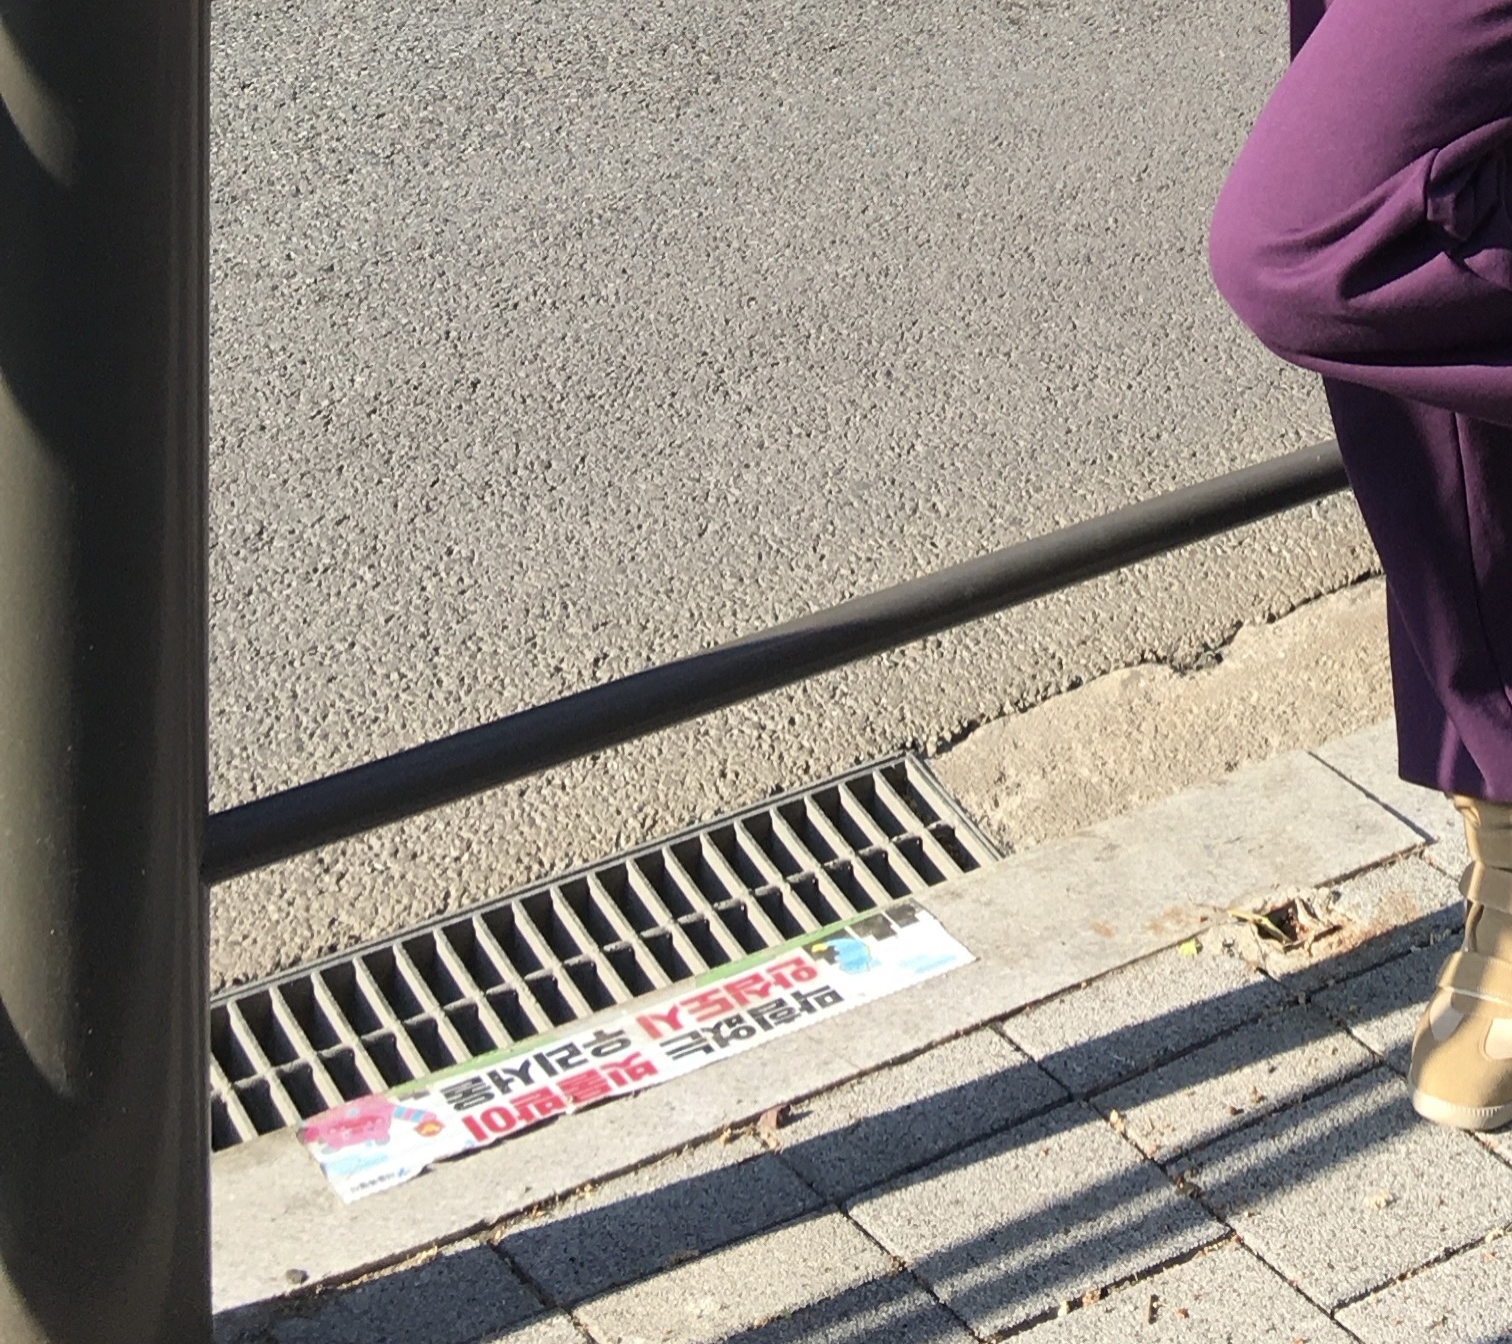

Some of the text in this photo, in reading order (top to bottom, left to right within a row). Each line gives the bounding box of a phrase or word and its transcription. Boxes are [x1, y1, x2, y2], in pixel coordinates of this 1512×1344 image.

[442, 956, 818, 1110] 안심도시 우리서울
[462, 985, 844, 1142] 막힘없는 빗물받이
